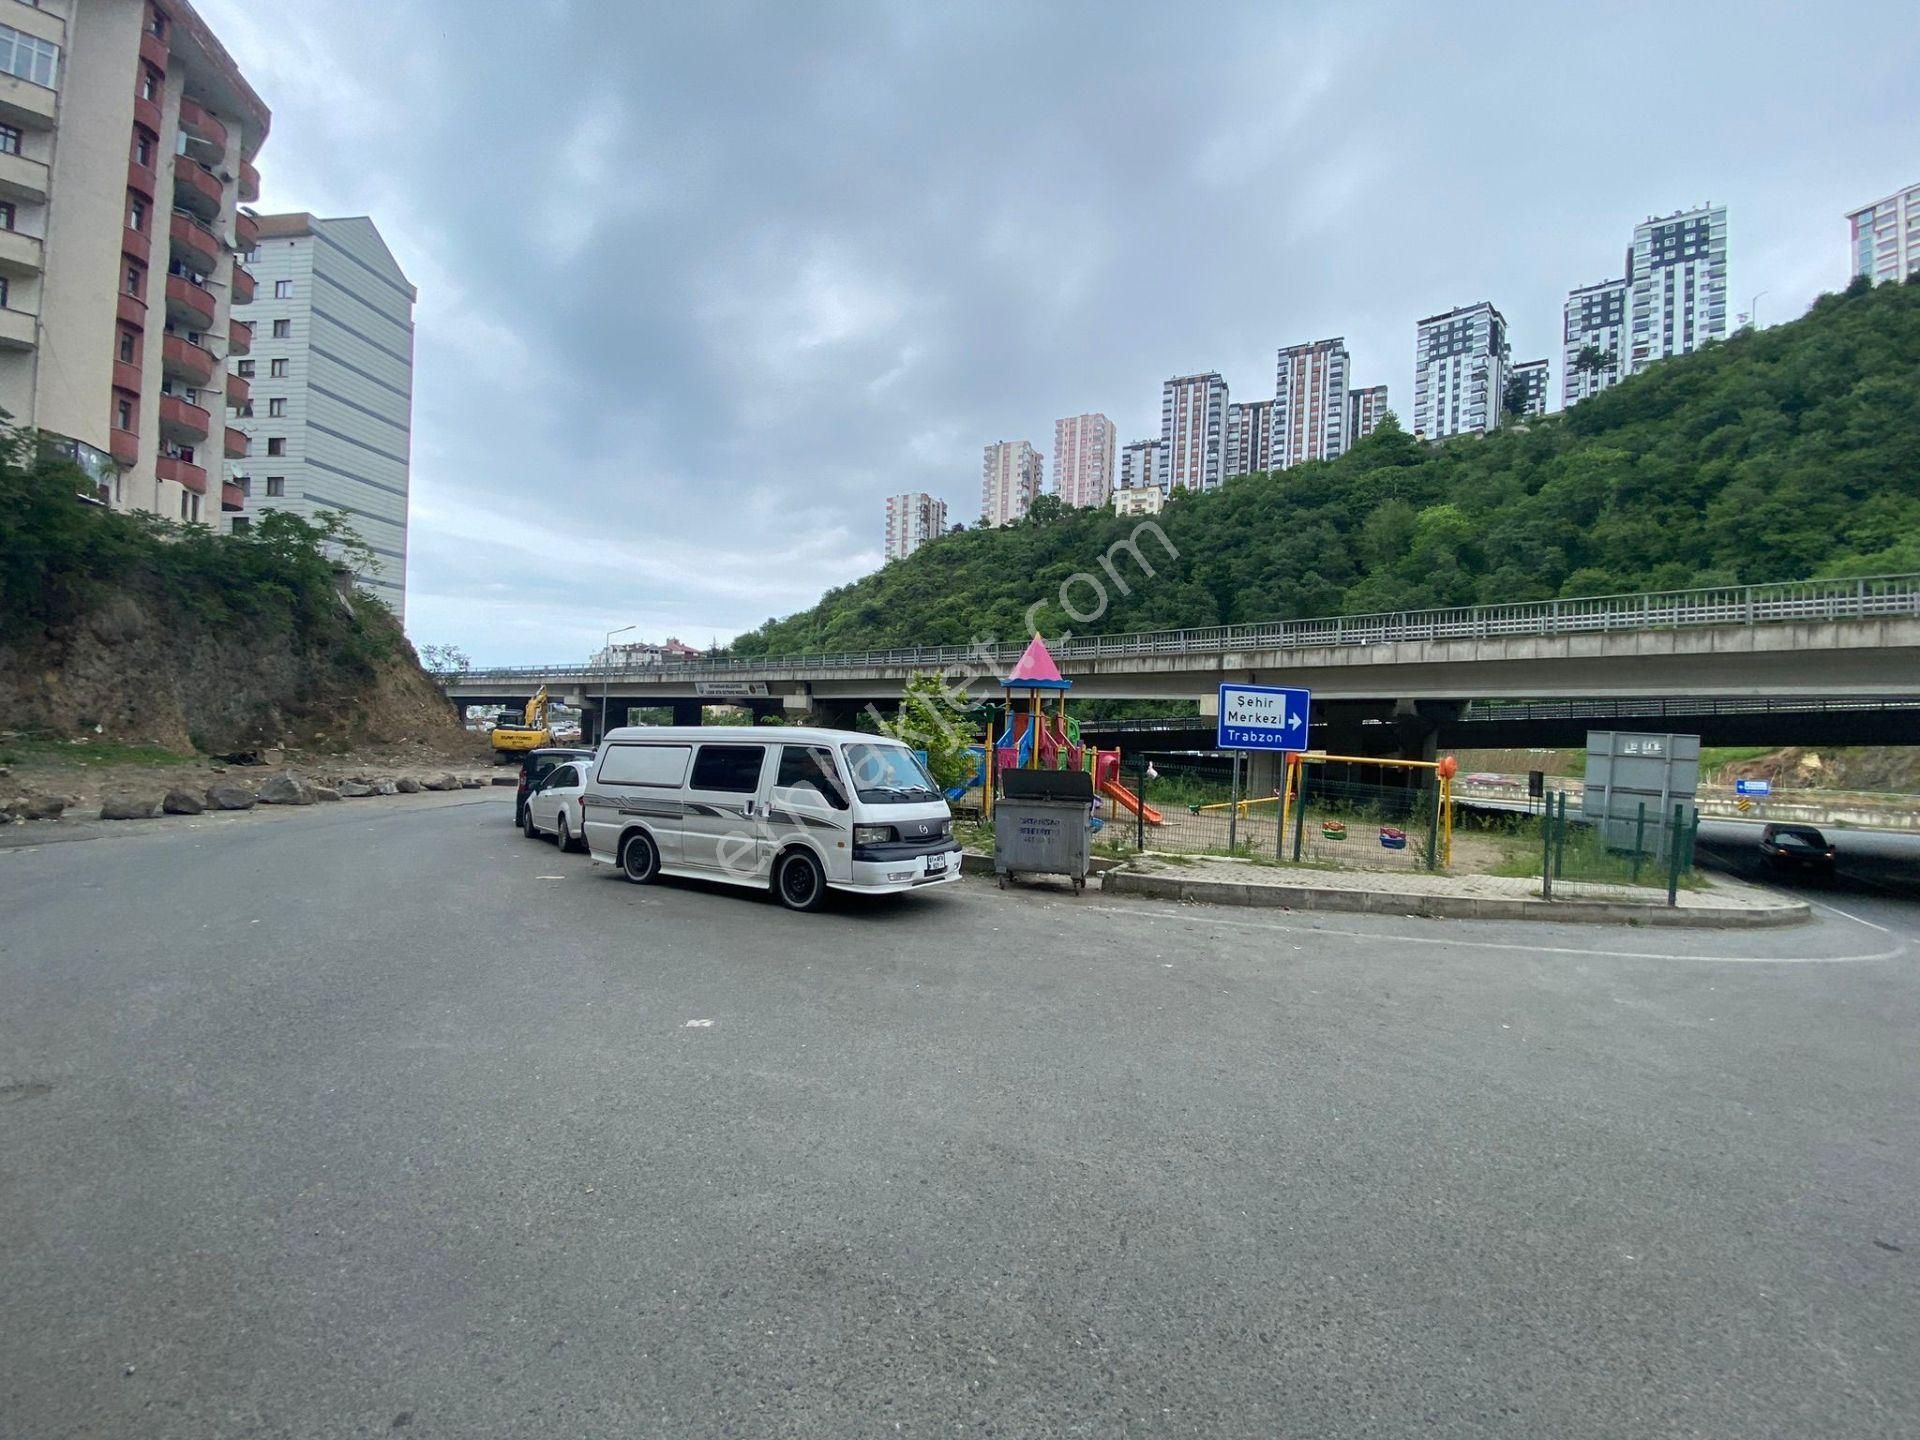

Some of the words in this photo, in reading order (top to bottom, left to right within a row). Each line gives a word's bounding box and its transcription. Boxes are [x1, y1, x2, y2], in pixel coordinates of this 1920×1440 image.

[1237, 695, 1274, 708] Şehir
[1228, 710, 1282, 725] Merkezi
[1227, 729, 1283, 743] Trabzon
